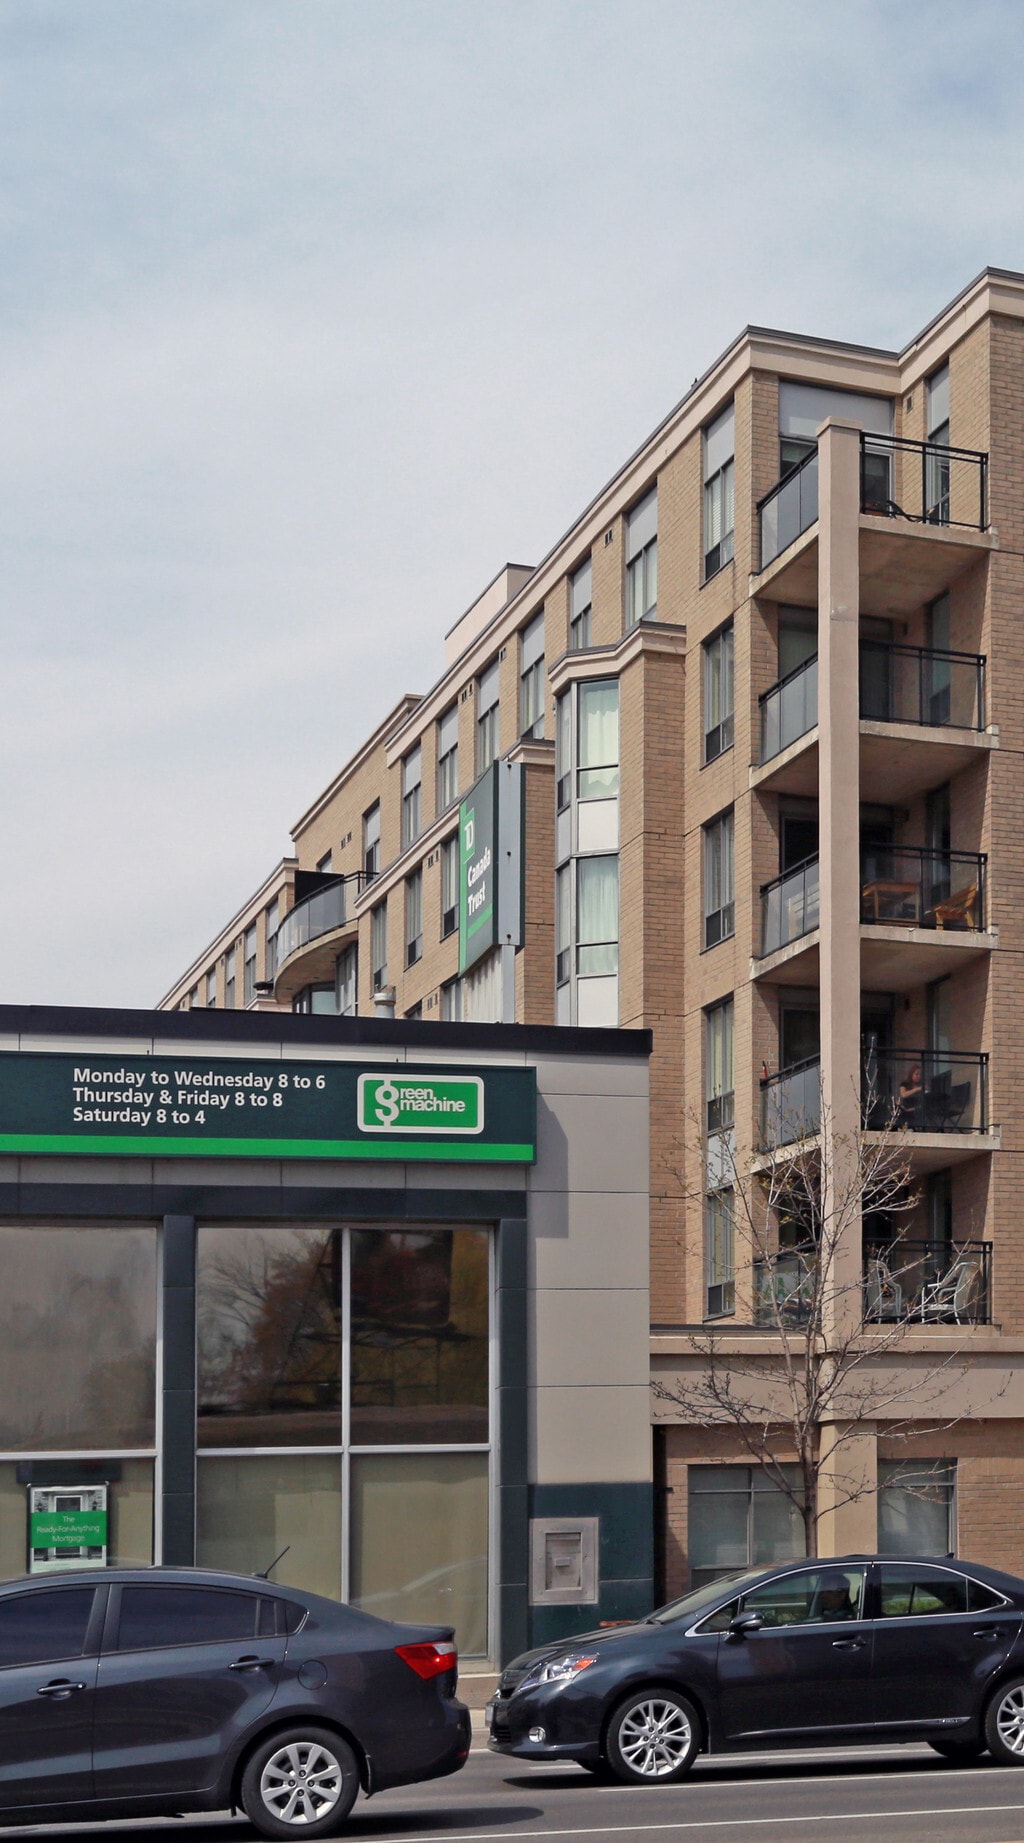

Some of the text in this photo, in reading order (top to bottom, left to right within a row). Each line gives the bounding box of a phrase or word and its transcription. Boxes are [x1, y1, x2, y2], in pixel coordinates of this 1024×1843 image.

[464, 820, 474, 851] TD
[468, 846, 491, 888] Canada
[468, 881, 486, 916] Trust
[73, 1068, 326, 1091] Monday to Wednesday 8 to 6
[73, 1087, 283, 1109] Thursday & Friday 8 to 8
[400, 1097, 466, 1112] machine
[73, 1107, 206, 1126] Saturday 8 to 4
[52, 1535, 85, 1543] Mortgage
